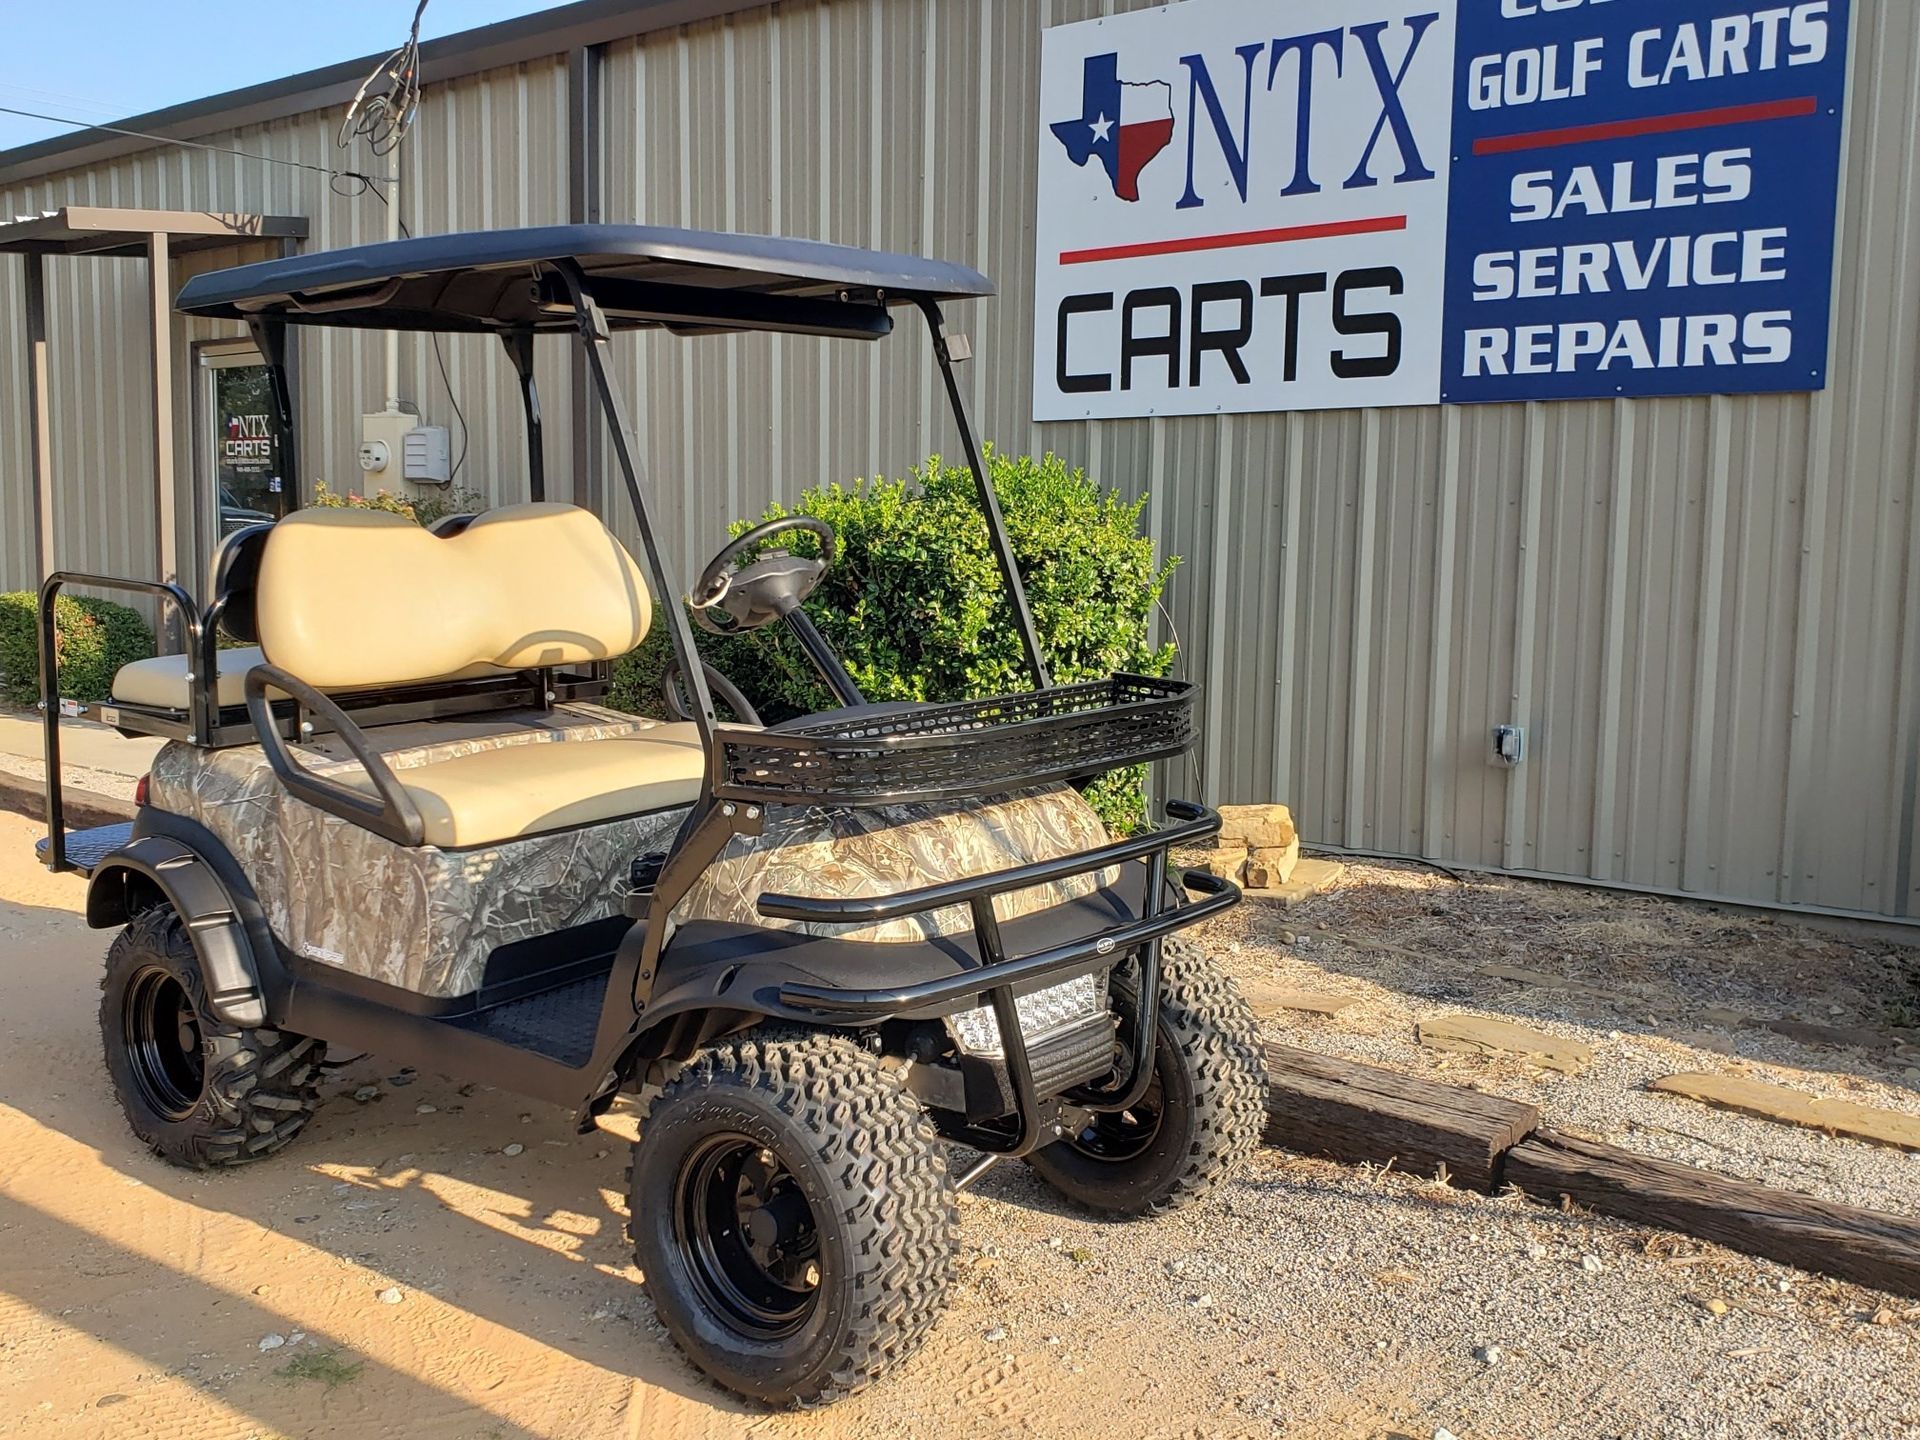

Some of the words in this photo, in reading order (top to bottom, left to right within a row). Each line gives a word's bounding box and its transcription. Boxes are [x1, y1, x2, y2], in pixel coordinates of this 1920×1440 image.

[1466, 36, 1605, 111] GOLF
[1626, 0, 1830, 89] CARTS
[1175, 12, 1440, 209] NTX
[1510, 147, 1753, 223] SALES
[1472, 227, 1788, 302] SERVICE
[1056, 266, 1405, 394] CARTS
[1462, 309, 1793, 378] REPAIRS
[226, 440, 270, 456] CARTS
[238, 415, 270, 437] NTX
